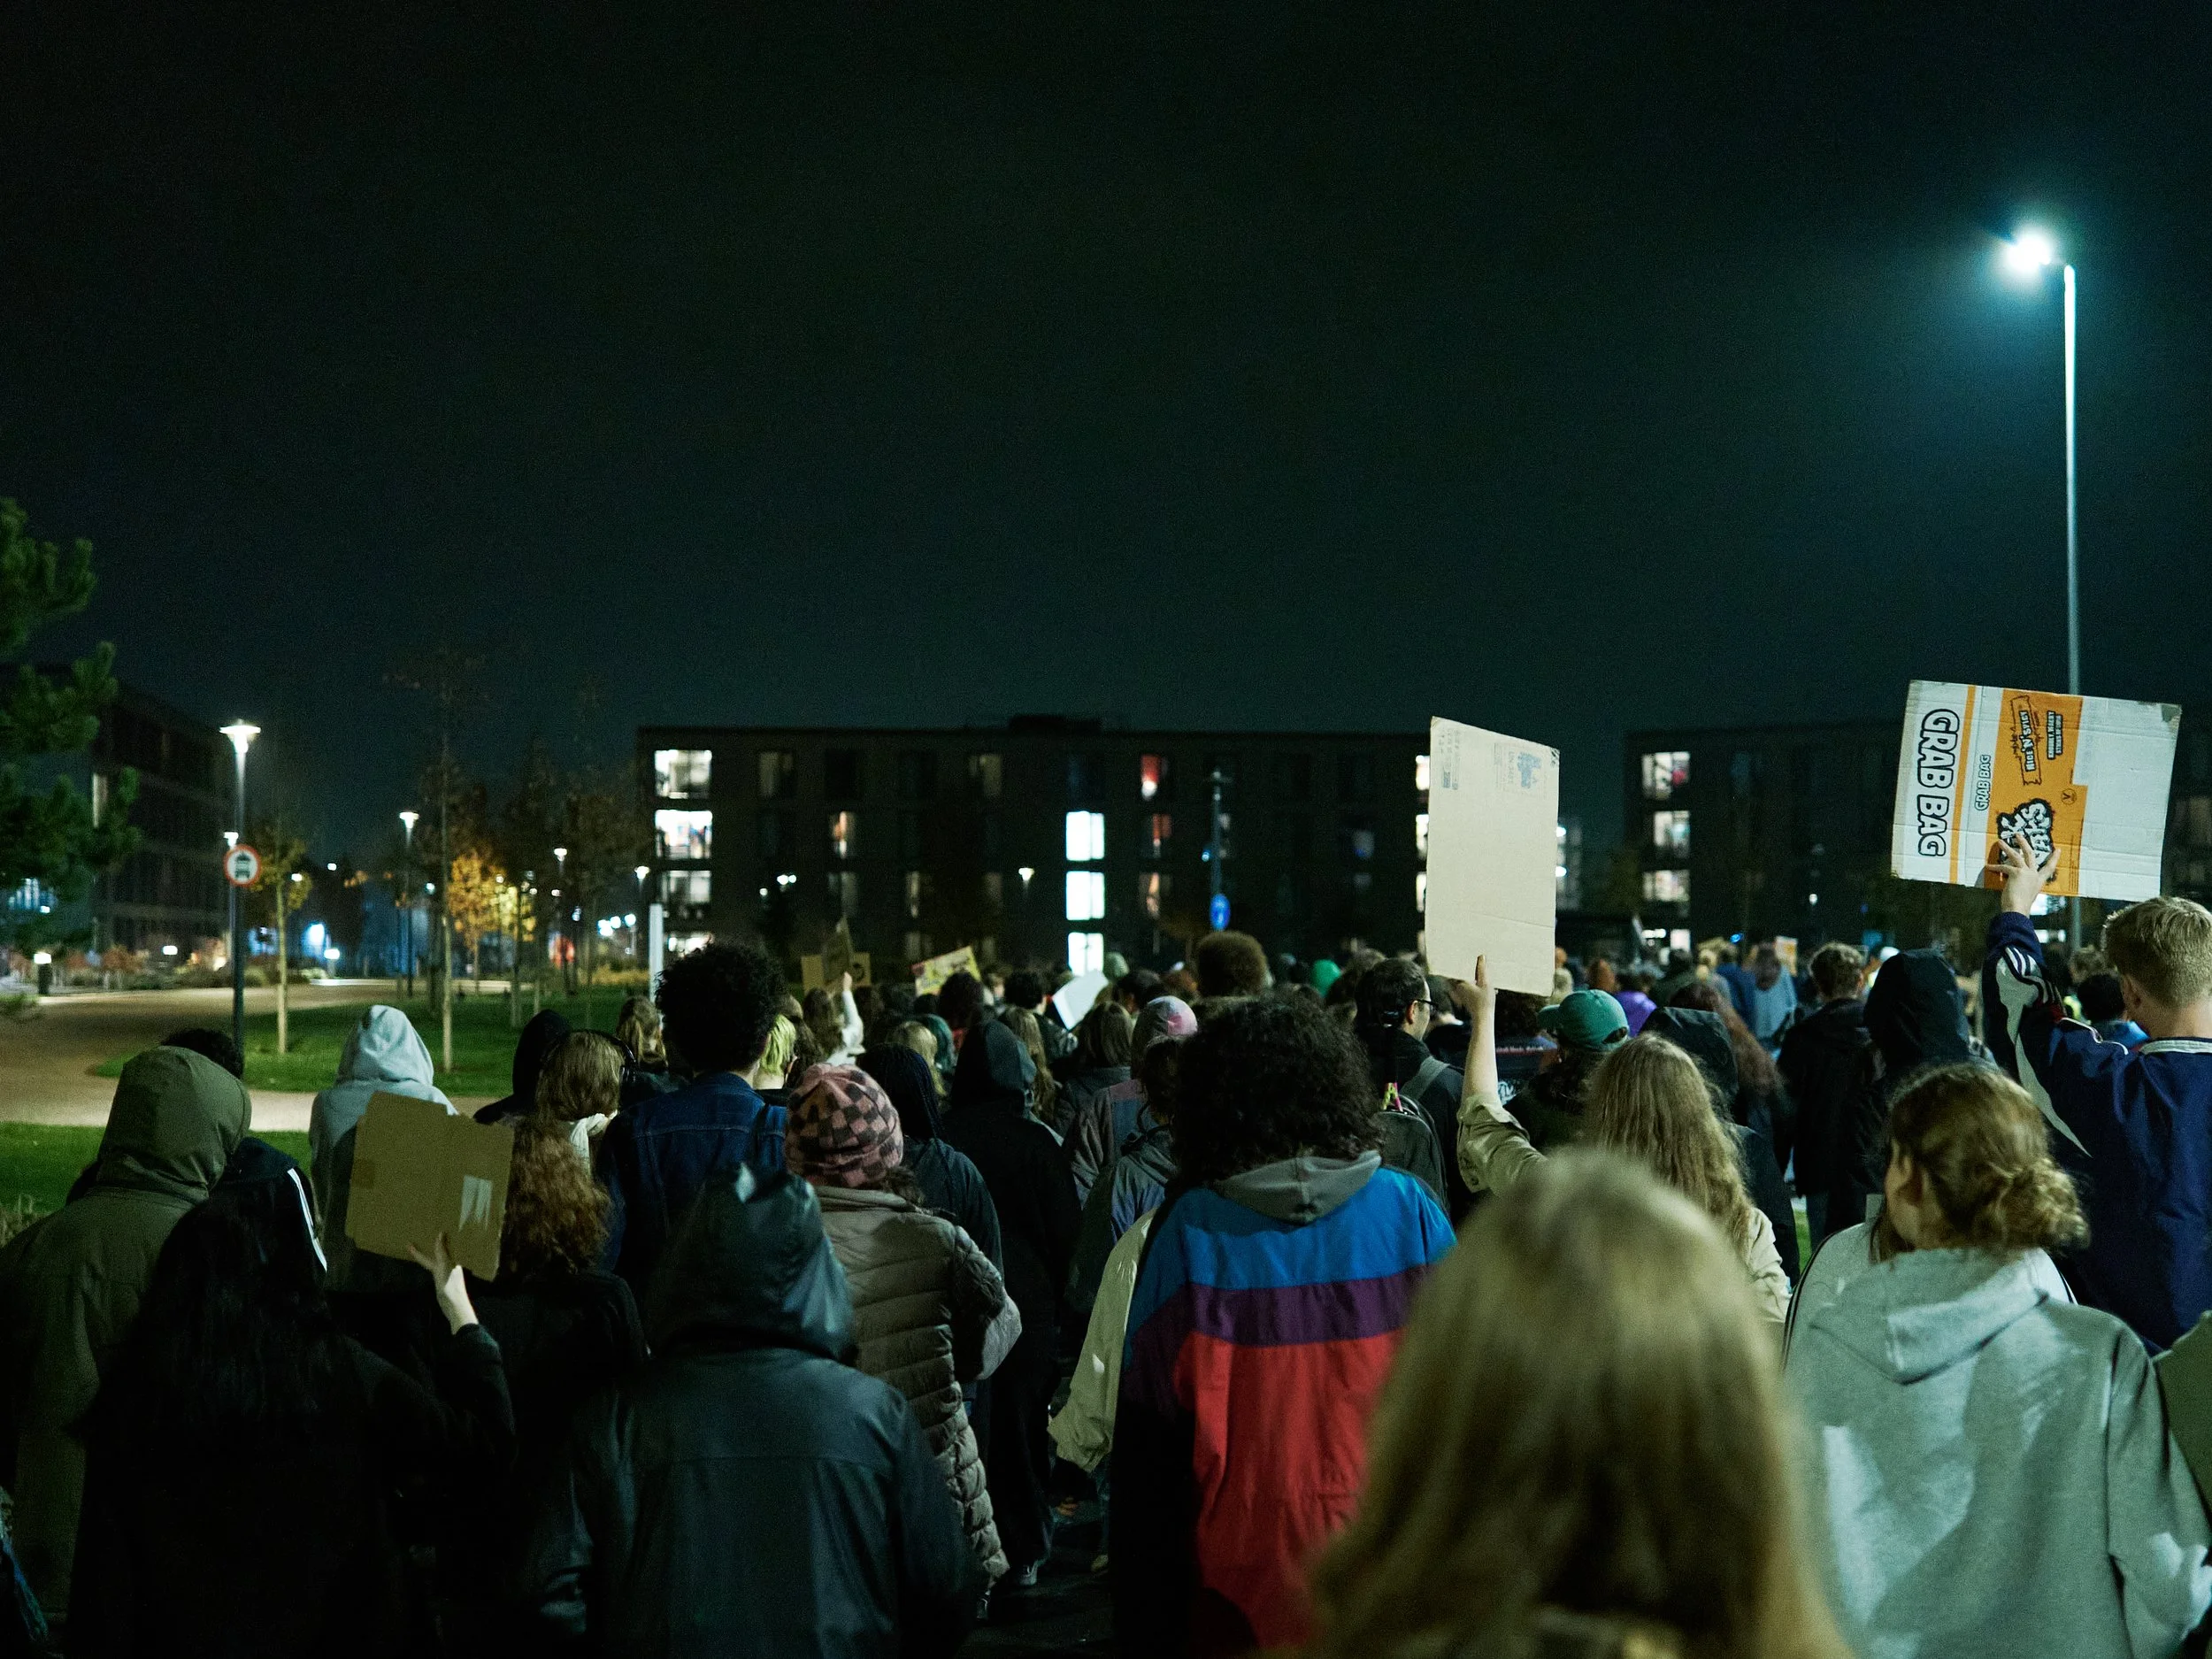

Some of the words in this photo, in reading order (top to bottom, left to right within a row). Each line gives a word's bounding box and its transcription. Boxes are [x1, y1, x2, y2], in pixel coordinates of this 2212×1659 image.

[1917, 709, 1959, 788] GRAB
[1978, 755, 1992, 779] BAG
[1975, 780, 1991, 810] GRAB
[1917, 795, 1949, 856] BAG
